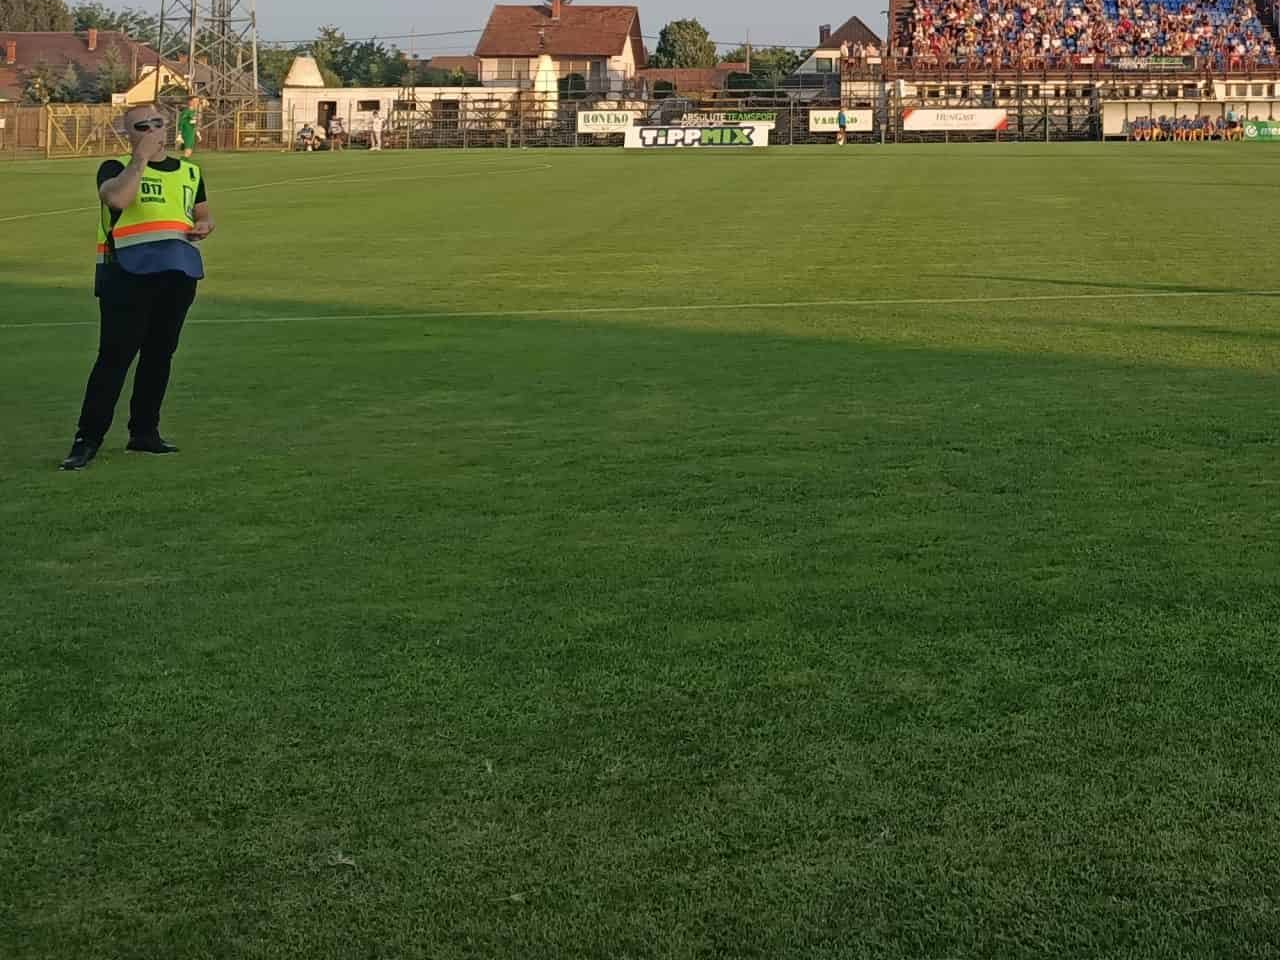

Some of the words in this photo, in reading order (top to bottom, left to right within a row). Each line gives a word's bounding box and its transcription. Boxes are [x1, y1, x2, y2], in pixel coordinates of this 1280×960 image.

[583, 113, 629, 124] BONEKO
[681, 112, 726, 121] ABSOLUTE
[727, 112, 777, 121] TEAMSPORT
